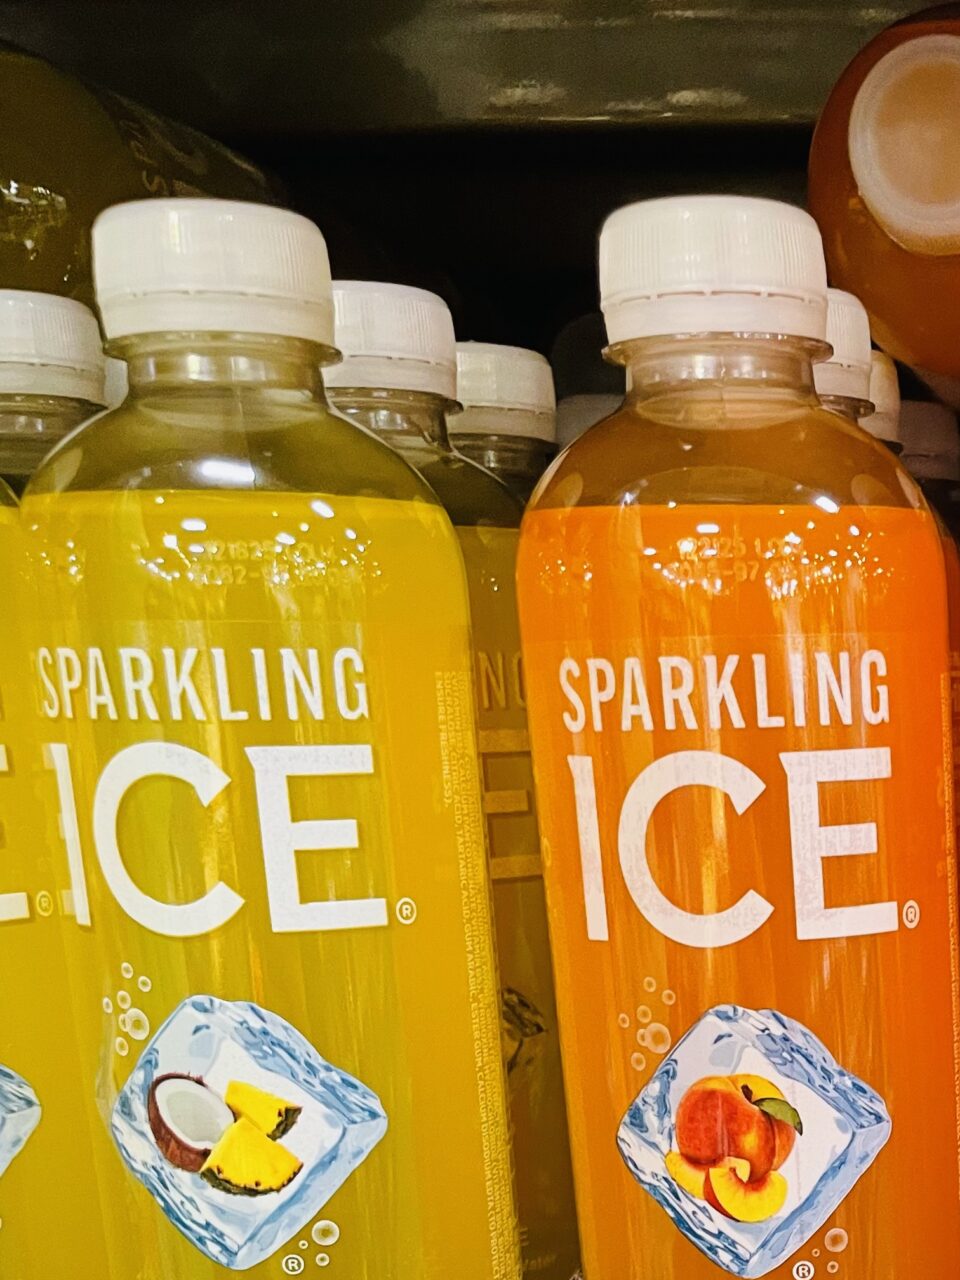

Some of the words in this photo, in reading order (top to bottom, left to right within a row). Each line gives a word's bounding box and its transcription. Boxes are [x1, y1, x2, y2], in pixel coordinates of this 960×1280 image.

[37, 647, 369, 721] SPARKLING
[559, 649, 890, 734] SPARKLING
[50, 742, 389, 936] ICE
[566, 747, 899, 948] ICE
